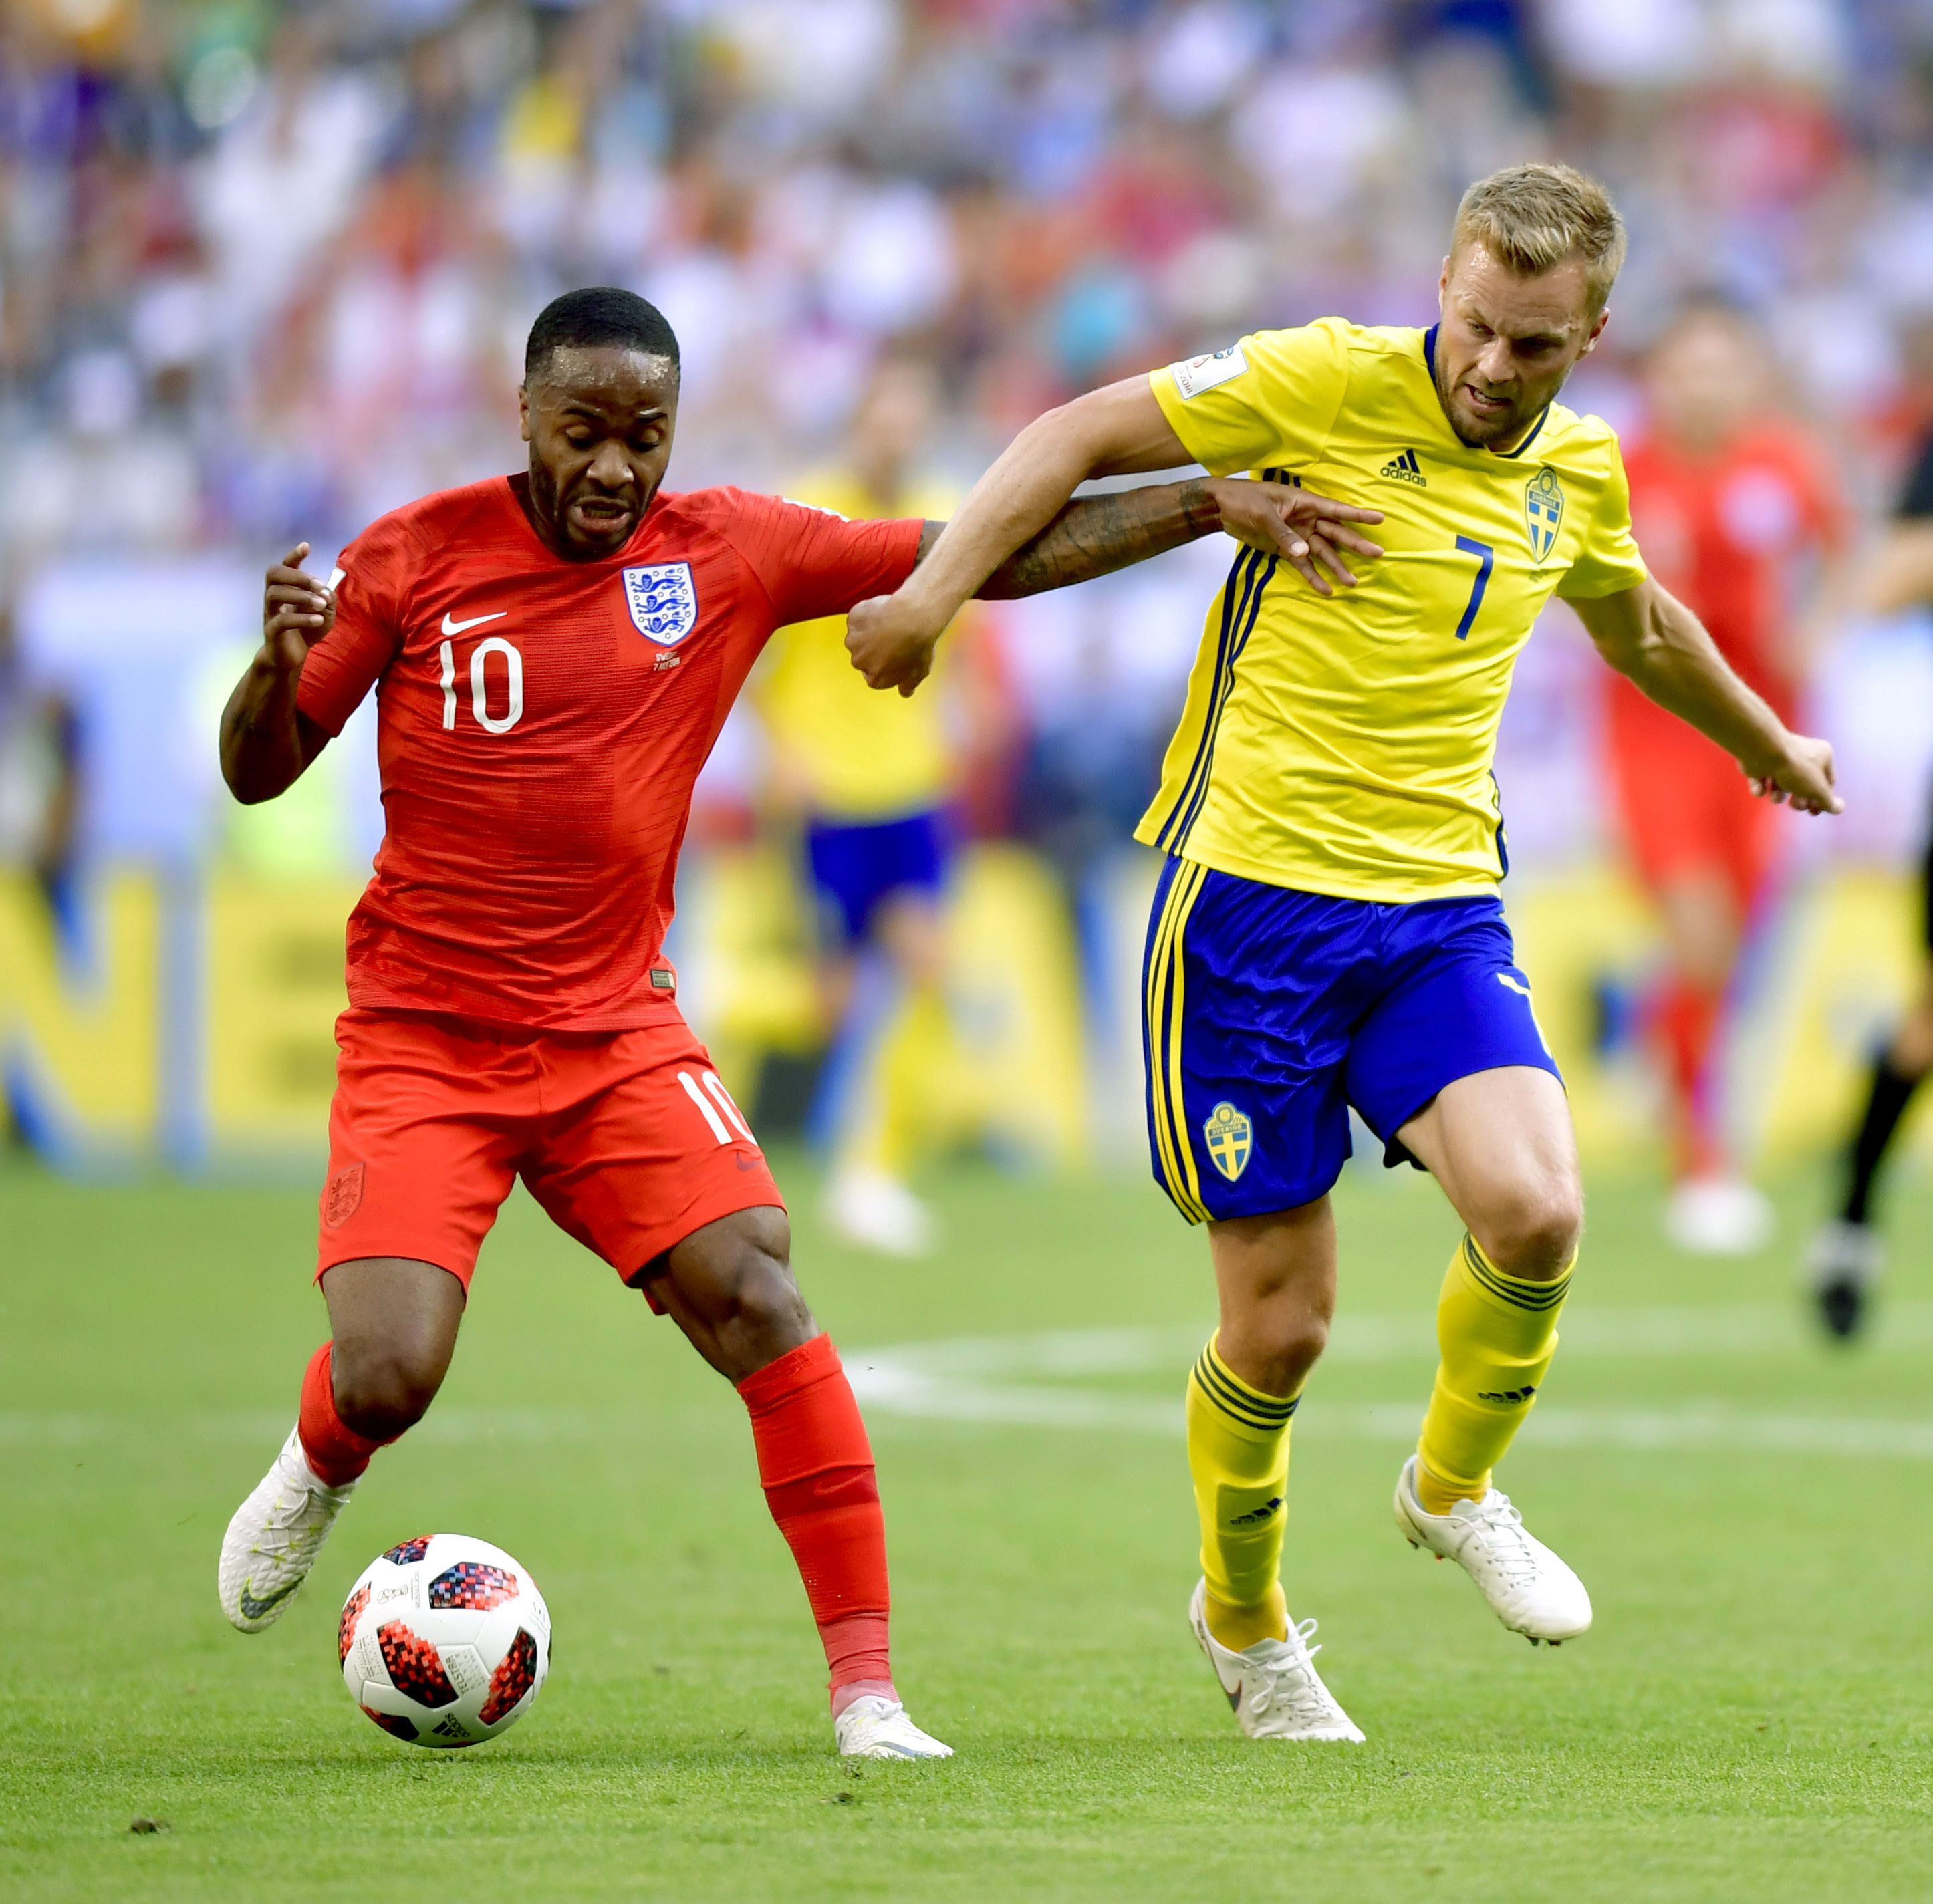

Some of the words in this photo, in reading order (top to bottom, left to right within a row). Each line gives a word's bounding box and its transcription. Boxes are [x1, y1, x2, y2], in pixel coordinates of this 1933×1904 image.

[1380, 466, 1427, 487] adidas
[1455, 534, 1493, 640] 7
[440, 636, 523, 734] 10
[676, 1071, 759, 1147] 10
[445, 1655, 469, 1695] TELSTAR
